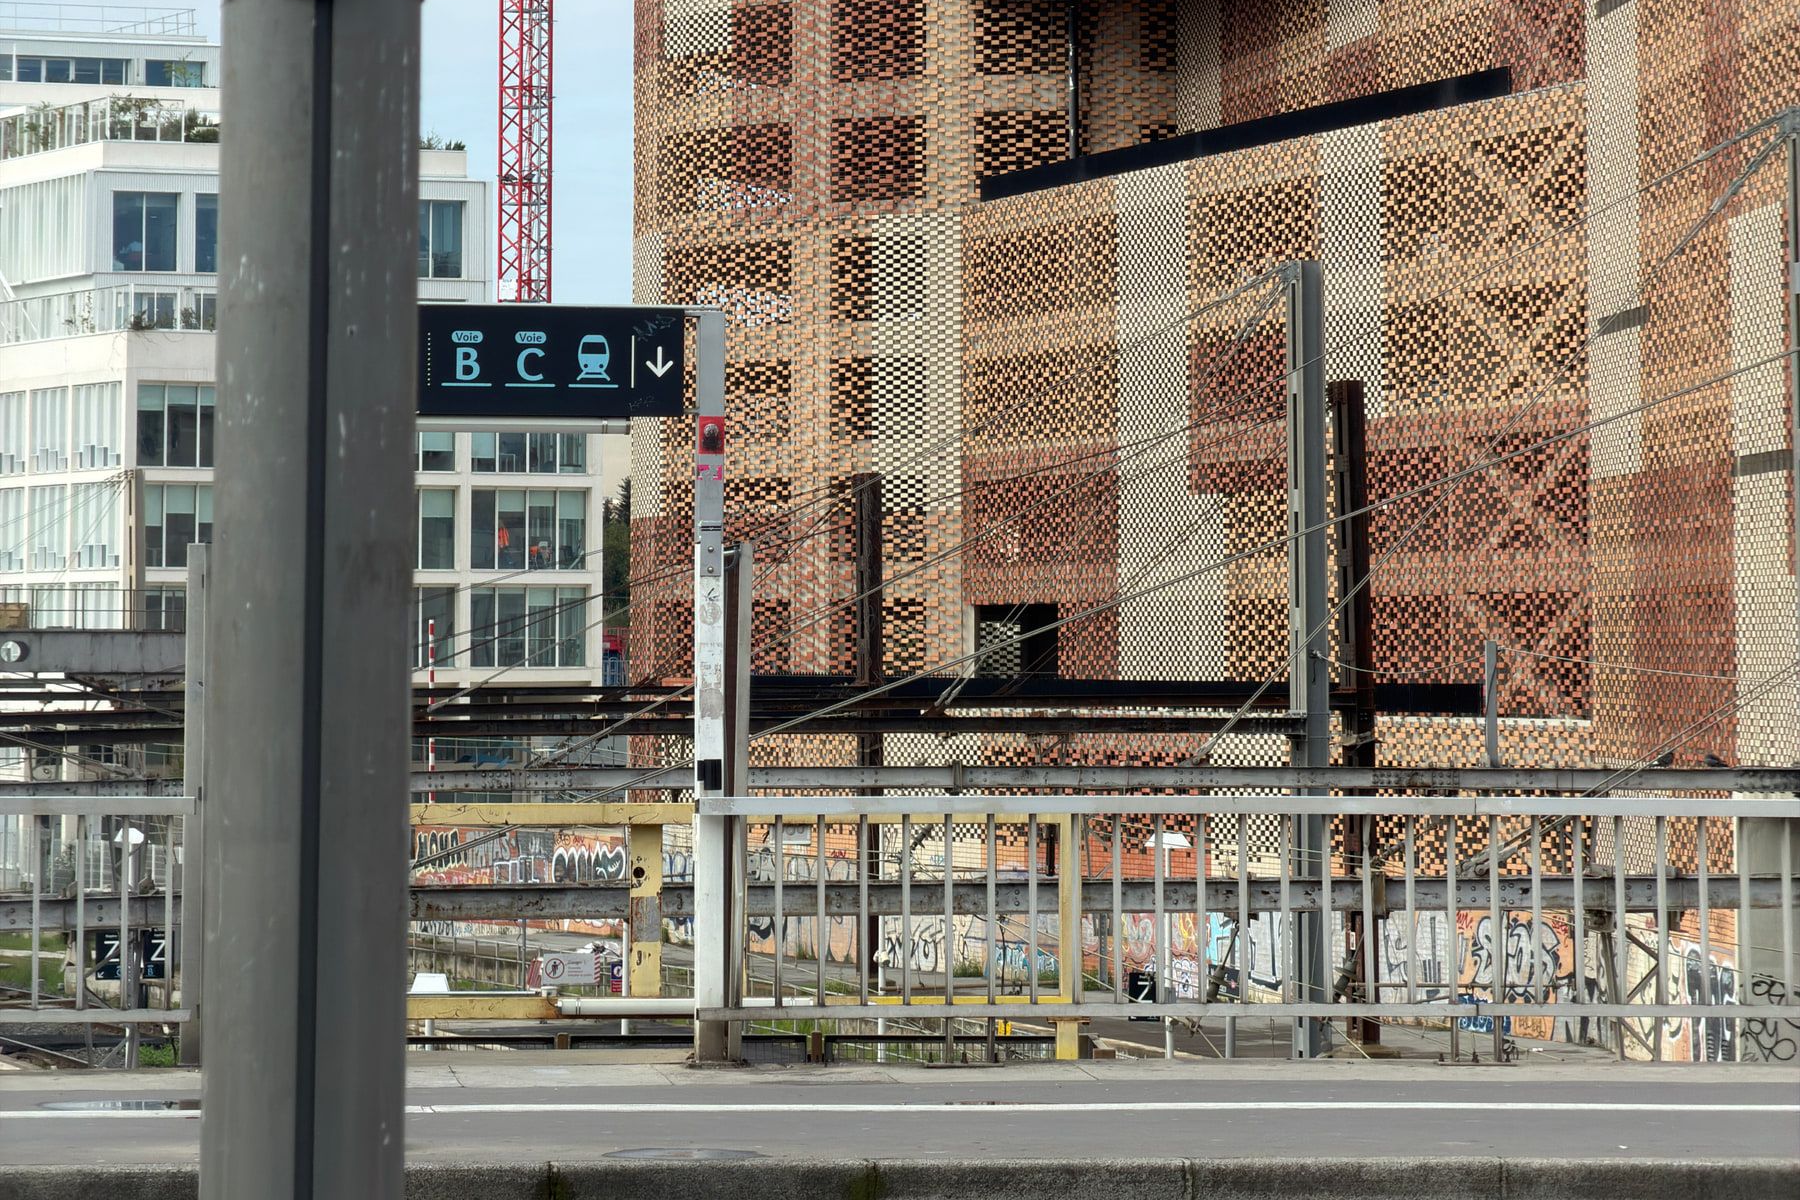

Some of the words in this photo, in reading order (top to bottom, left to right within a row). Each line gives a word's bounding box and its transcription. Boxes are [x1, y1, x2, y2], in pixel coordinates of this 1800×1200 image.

[455, 332, 479, 342] Voie
[518, 333, 542, 343] Voie
[456, 347, 480, 380] B
[517, 348, 545, 381] C
[151, 940, 166, 961] Z
[1137, 981, 1153, 1003] Z
